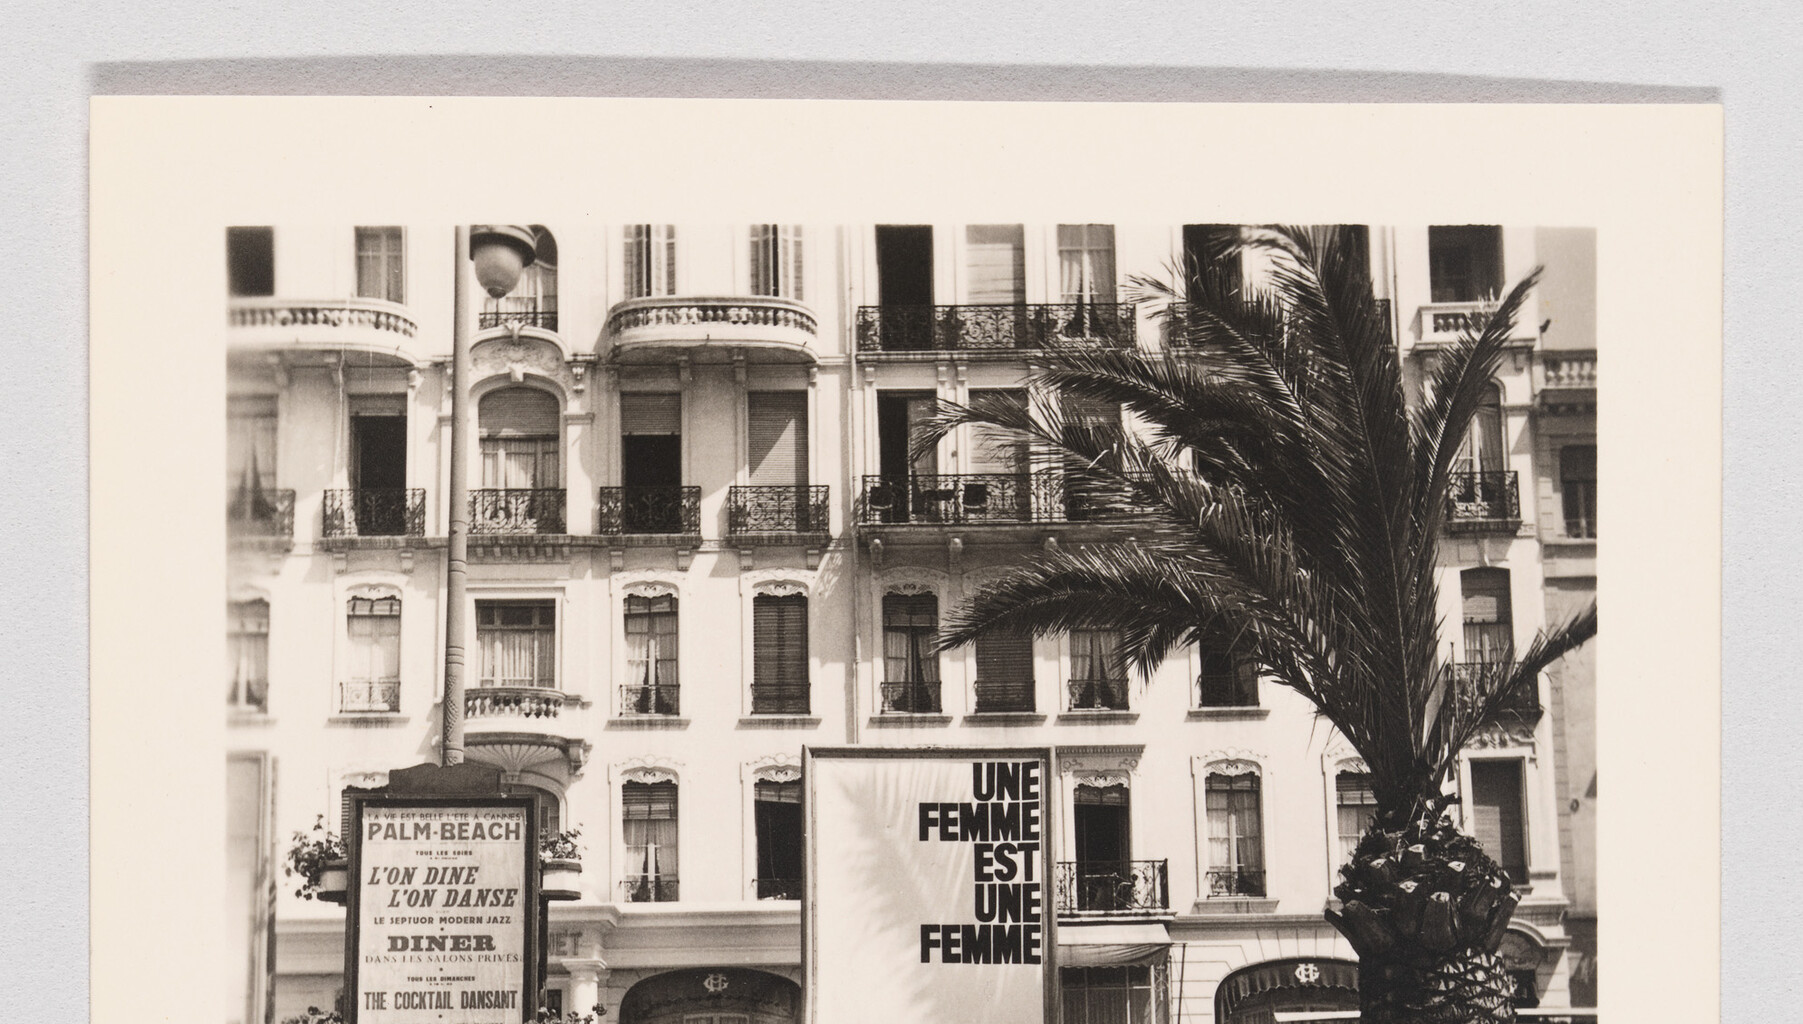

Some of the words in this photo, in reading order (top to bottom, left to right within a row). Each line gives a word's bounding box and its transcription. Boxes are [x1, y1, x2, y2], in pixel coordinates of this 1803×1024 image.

[972, 761, 1040, 801] UNE
[368, 813, 379, 821] LA
[384, 813, 397, 821] VIE
[420, 813, 443, 821] BELLE
[483, 812, 521, 821] CANNES
[919, 801, 1040, 841] FEMME
[974, 842, 1040, 882] EST
[368, 866, 417, 885] L'ON
[422, 866, 479, 885] DINE
[387, 889, 438, 908] L'ON
[442, 888, 518, 908] DANSE
[974, 883, 1041, 923] UNE
[374, 917, 385, 925] LE
[390, 916, 434, 925] SEPTUOR
[439, 916, 483, 924] MODERN
[486, 916, 511, 924] JAZZ
[387, 934, 496, 952] DINER
[920, 924, 1041, 965] FEMME
[365, 955, 397, 963] DANS
[402, 955, 422, 963] LES
[427, 954, 473, 963] SALONS
[364, 991, 388, 1010] THE
[394, 991, 454, 1010] COCKTAIL
[460, 990, 518, 1009] DANSANT
